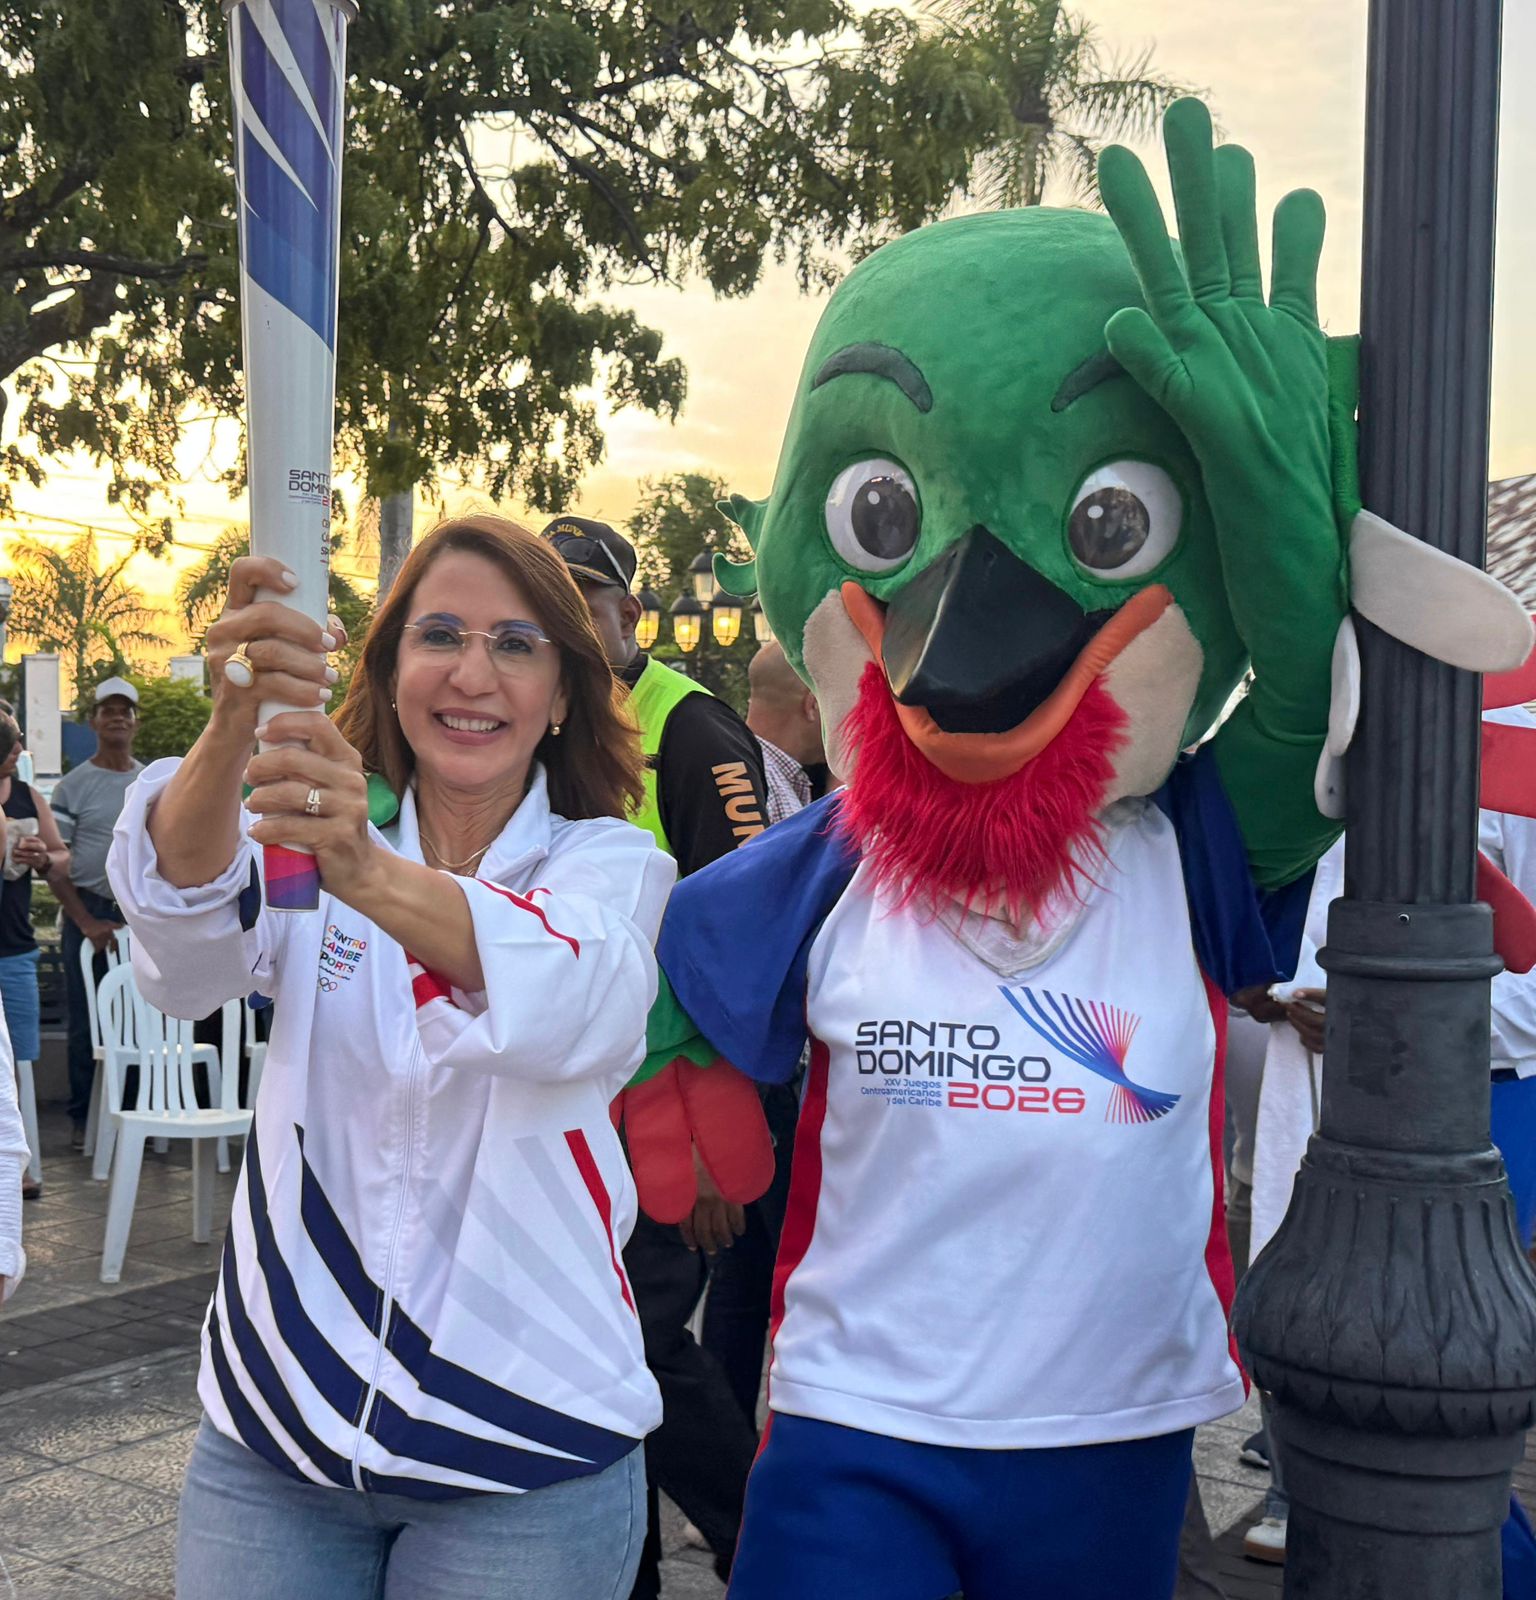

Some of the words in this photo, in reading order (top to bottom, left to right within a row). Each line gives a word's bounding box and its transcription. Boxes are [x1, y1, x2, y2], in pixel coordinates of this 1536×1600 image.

[289, 480, 330, 496] DOMIN
[322, 936, 362, 963] CARIBE
[328, 924, 367, 950] CENTRO
[320, 951, 356, 974] PORTS
[855, 1020, 1001, 1051] SANTO
[856, 1049, 1051, 1083] DOMINGO
[883, 1078, 901, 1087] XXV
[903, 1078, 942, 1089] Juegos
[892, 1096, 906, 1105] del
[908, 1096, 942, 1107] Caribe
[947, 1081, 1086, 1114] 2026
